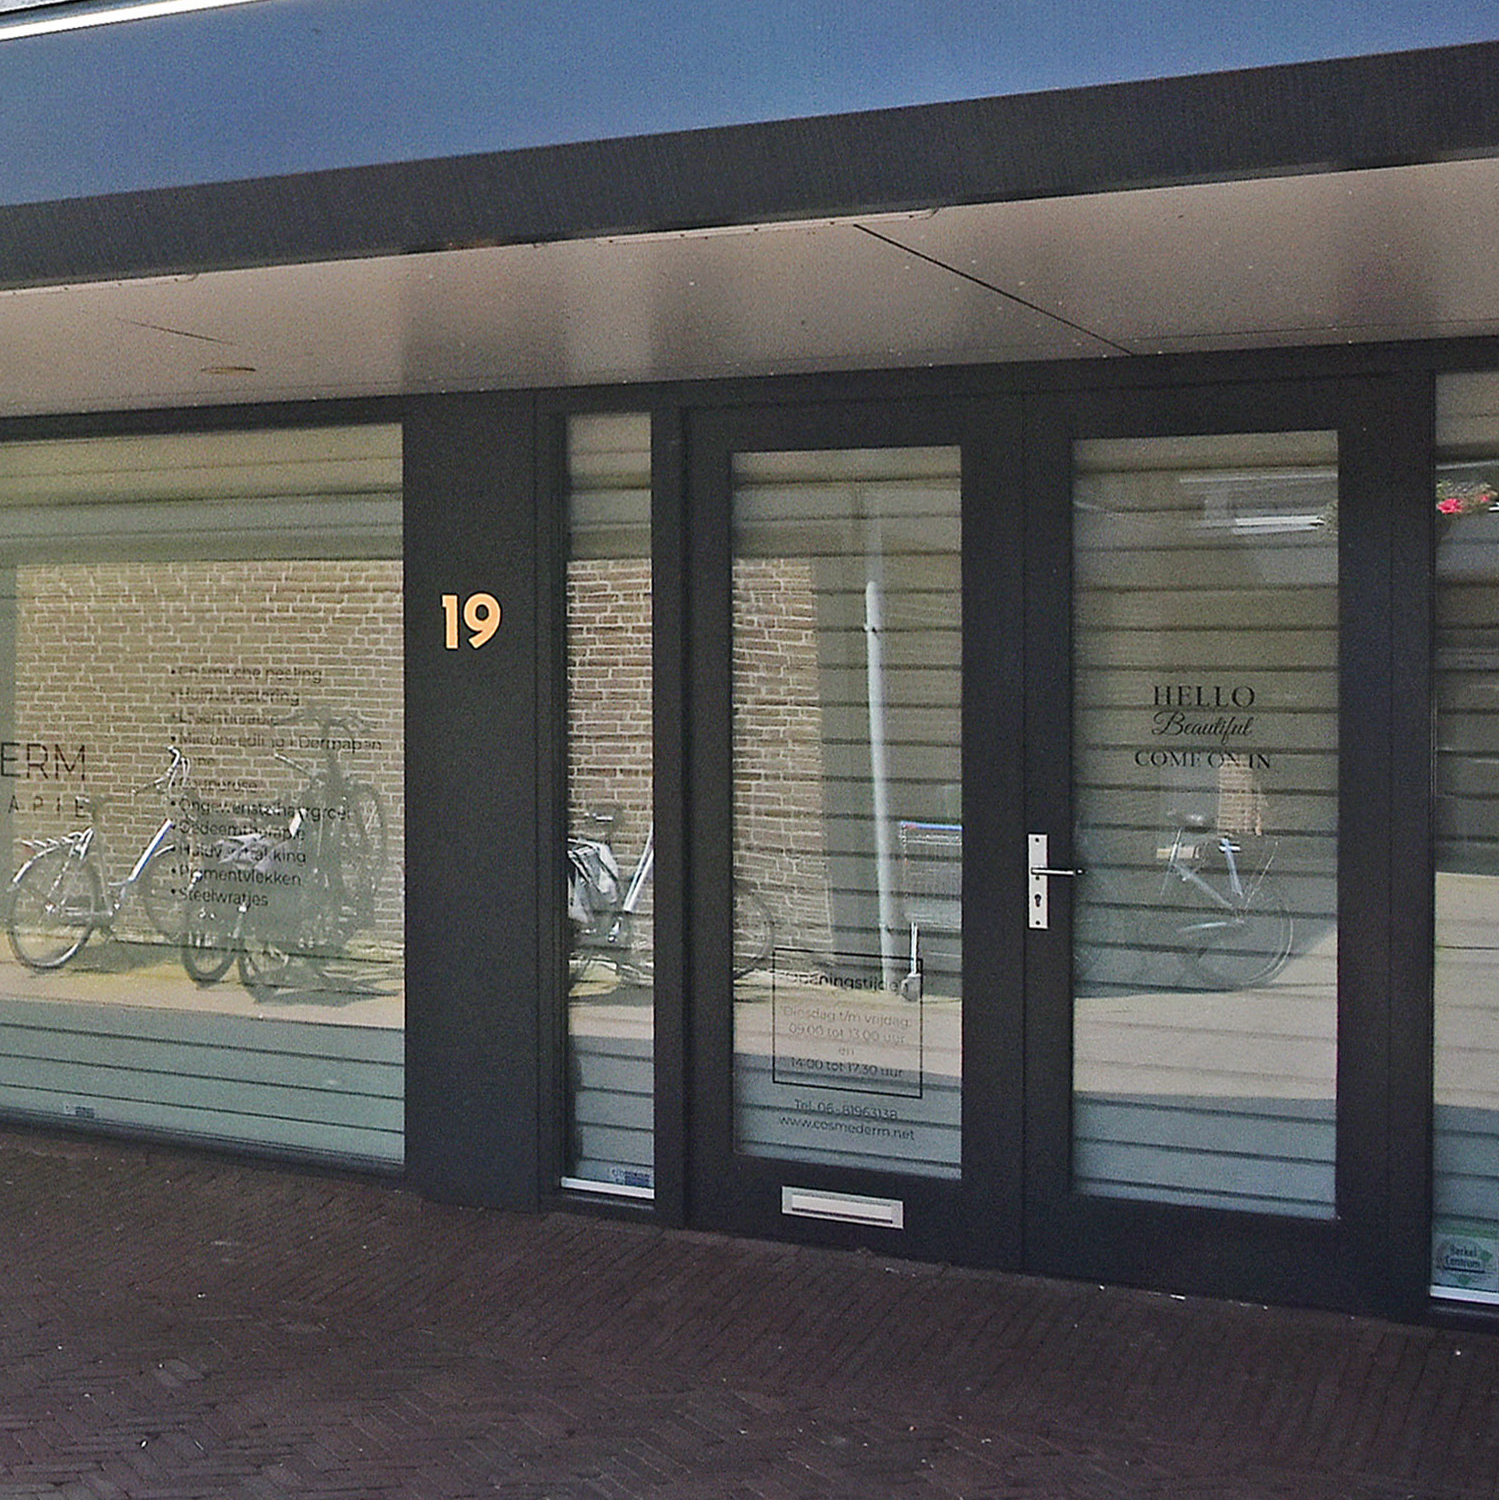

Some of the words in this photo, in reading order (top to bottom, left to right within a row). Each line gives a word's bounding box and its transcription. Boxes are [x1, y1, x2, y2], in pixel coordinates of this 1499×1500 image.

[441, 592, 501, 649] 19
[265, 665, 323, 684] peeling
[1154, 685, 1255, 708] HELLO
[1151, 711, 1253, 745] Beautiful
[1135, 750, 1200, 767] COME
[1207, 752, 1240, 769] ON
[1248, 752, 1271, 769] IN
[276, 801, 352, 822] hargroei
[178, 885, 269, 909] Steelwratjes
[827, 1027, 845, 1038] tot
[883, 1034, 906, 1045] uur
[826, 1060, 844, 1073] tot
[880, 1068, 903, 1078] uur
[778, 1115, 915, 1141] www.cosmederm.net
